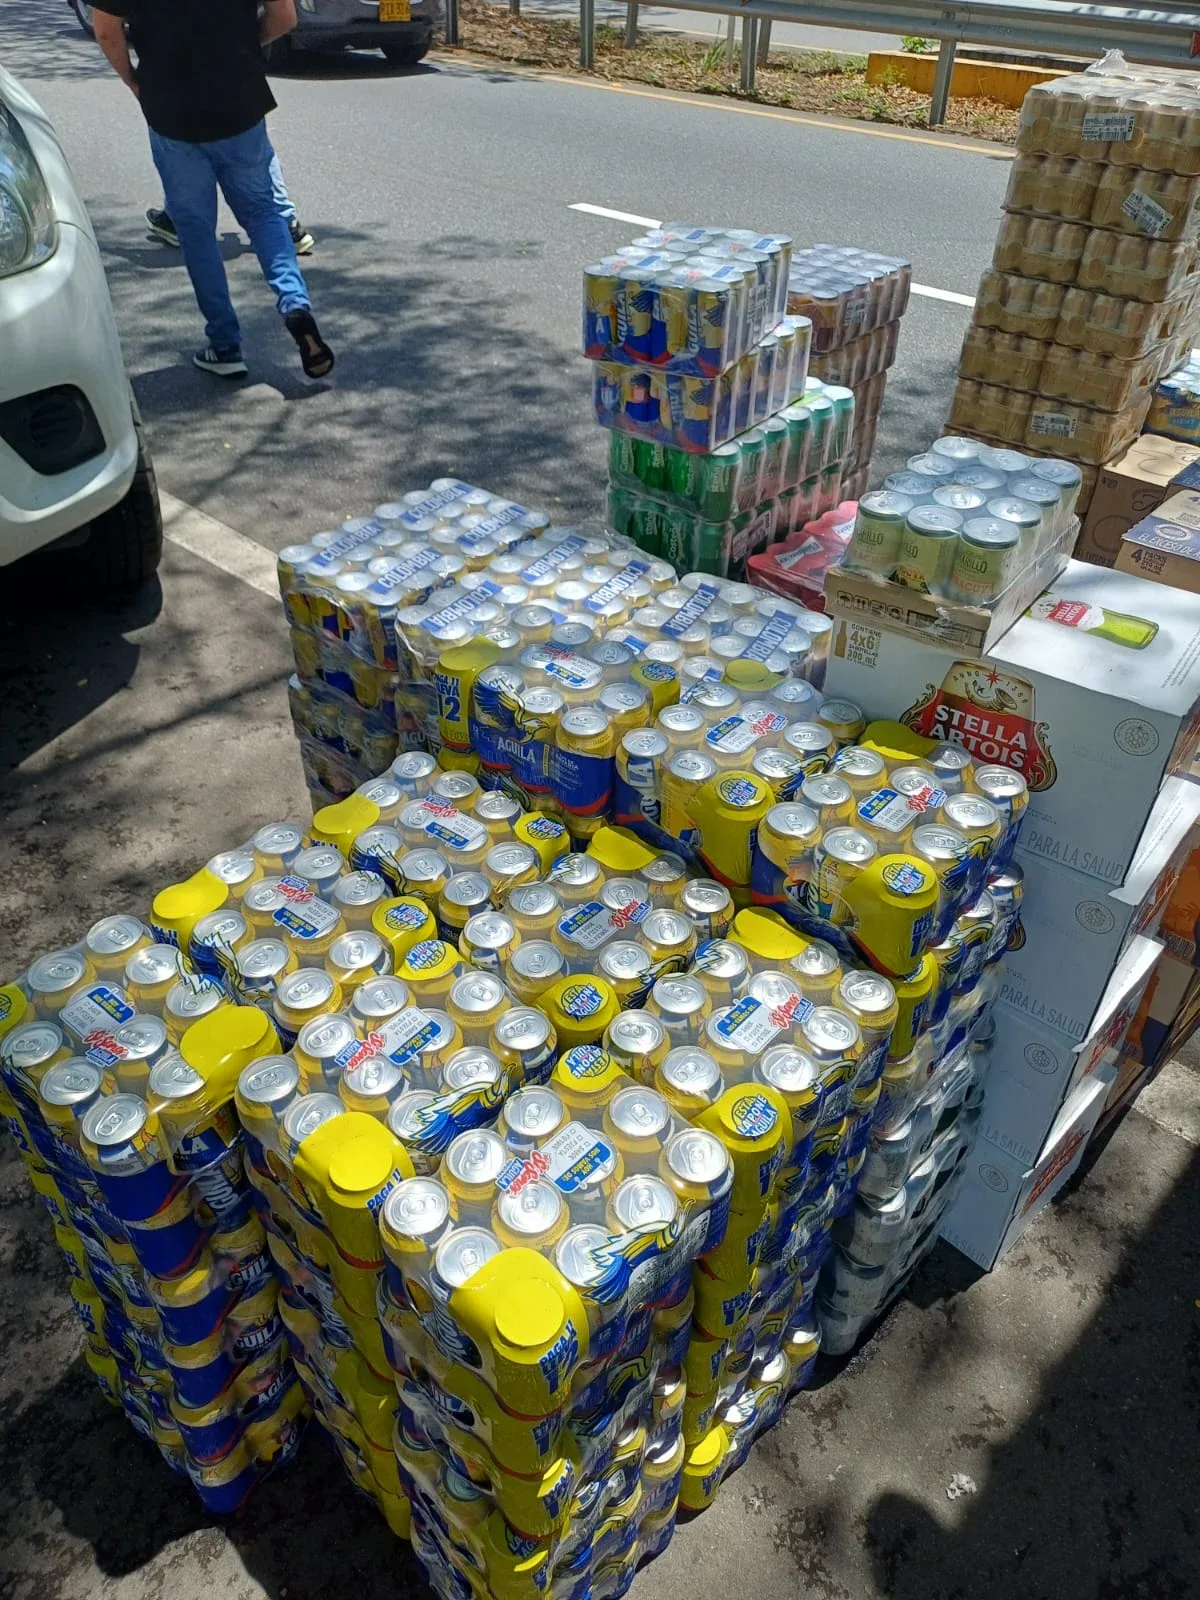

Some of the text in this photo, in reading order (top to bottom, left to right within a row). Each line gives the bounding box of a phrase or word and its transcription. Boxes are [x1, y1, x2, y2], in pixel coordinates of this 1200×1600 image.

[408, 485, 467, 520] COLOMBIA
[466, 504, 523, 543] COLOMBIA
[320, 524, 381, 561] COLOMBIA
[1131, 549, 1143, 562] 4
[377, 549, 439, 589] COLOMBIA
[524, 540, 581, 577] COLOMBIA
[588, 565, 644, 605] COLOMBIA
[428, 588, 494, 627] COLOMBIA
[671, 588, 716, 633] COLOMBIA
[747, 615, 792, 662] COLOMBIA
[934, 704, 1028, 751] STELLA
[497, 737, 536, 763] AGUILA
[929, 724, 1025, 769] ARTOIS
[1027, 830, 1124, 881] PARA LA SALUD
[630, 903, 649, 922] AGUILA
[406, 939, 431, 965] AGUILA
[412, 947, 436, 971] PONE
[426, 948, 446, 967] ESTA
[564, 986, 583, 1003] ESTA
[575, 995, 602, 1018] AGUILA
[577, 984, 596, 1005] PONE
[792, 999, 811, 1021] AGUILA
[1000, 984, 1085, 1037] PARA LA SALUD
[339, 1040, 361, 1063] AGUILA
[573, 1052, 599, 1079] PONE
[588, 1057, 609, 1077] ESTA
[735, 1096, 756, 1117] ESTA
[747, 1094, 769, 1122] PONE
[749, 1108, 778, 1138] AGUILA
[558, 1140, 578, 1156] FIESTA
[499, 1159, 523, 1188] AGUILA
[538, 1334, 572, 1372] PAGA
